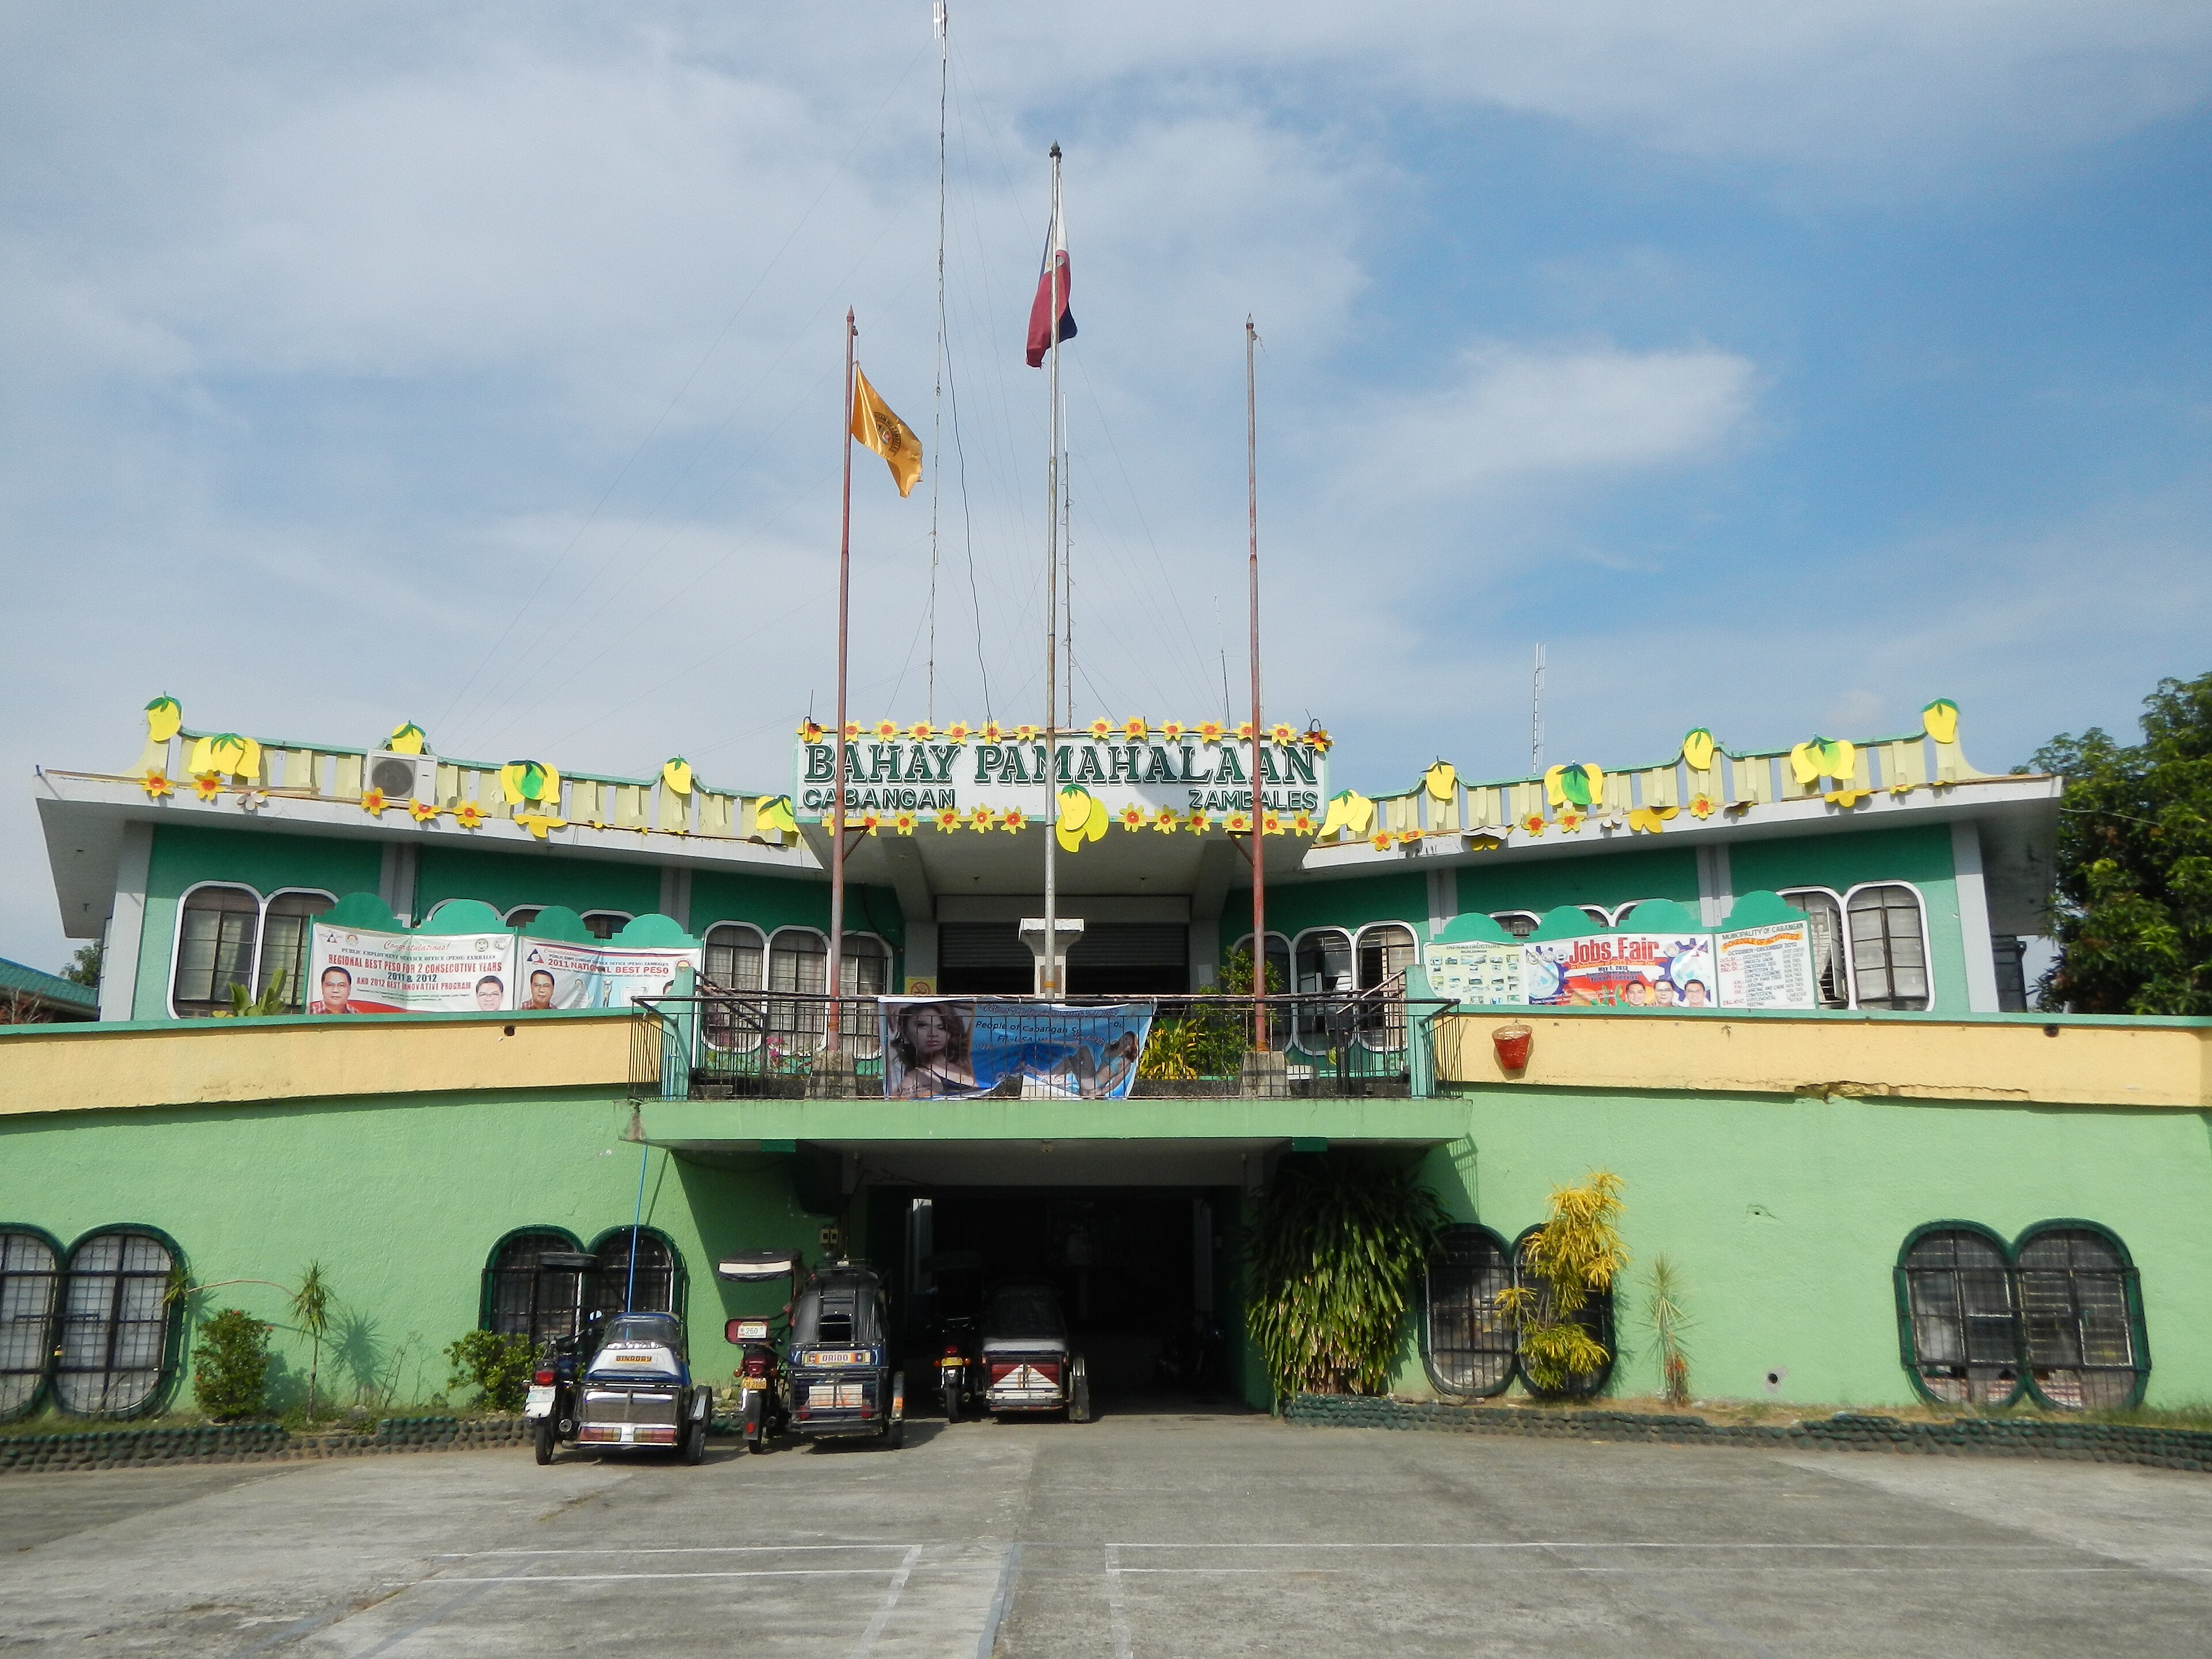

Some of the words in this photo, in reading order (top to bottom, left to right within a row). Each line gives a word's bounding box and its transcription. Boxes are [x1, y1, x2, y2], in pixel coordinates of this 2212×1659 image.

[804, 744, 961, 785] BAHAY
[974, 743, 1317, 786] PAMAHALAAN
[803, 788, 956, 810] CABANGAN
[1188, 790, 1319, 811] ZAMBALES
[384, 940, 452, 952] Congratulations!
[1569, 940, 1612, 964] Jobs
[1618, 937, 1660, 960] Fair
[328, 954, 362, 967] REGIONAL
[365, 958, 382, 969] BEST
[384, 960, 401, 972] PESO
[403, 963, 415, 974] FOR
[418, 963, 423, 974] 2
[425, 963, 476, 974] CONSECUTIVE
[479, 962, 502, 972] YEARS
[548, 959, 569, 968] 2011
[357, 977, 369, 985] AND
[370, 978, 385, 987] 2012
[387, 980, 400, 988] BEST
[402, 982, 438, 991] INNOVATIVE
[441, 982, 471, 990] PROGRAM
[387, 972, 405, 980] 2011
[416, 974, 437, 982] 2012
[976, 1021, 1007, 1031] People
[1022, 1025, 1068, 1034] Cabangan
